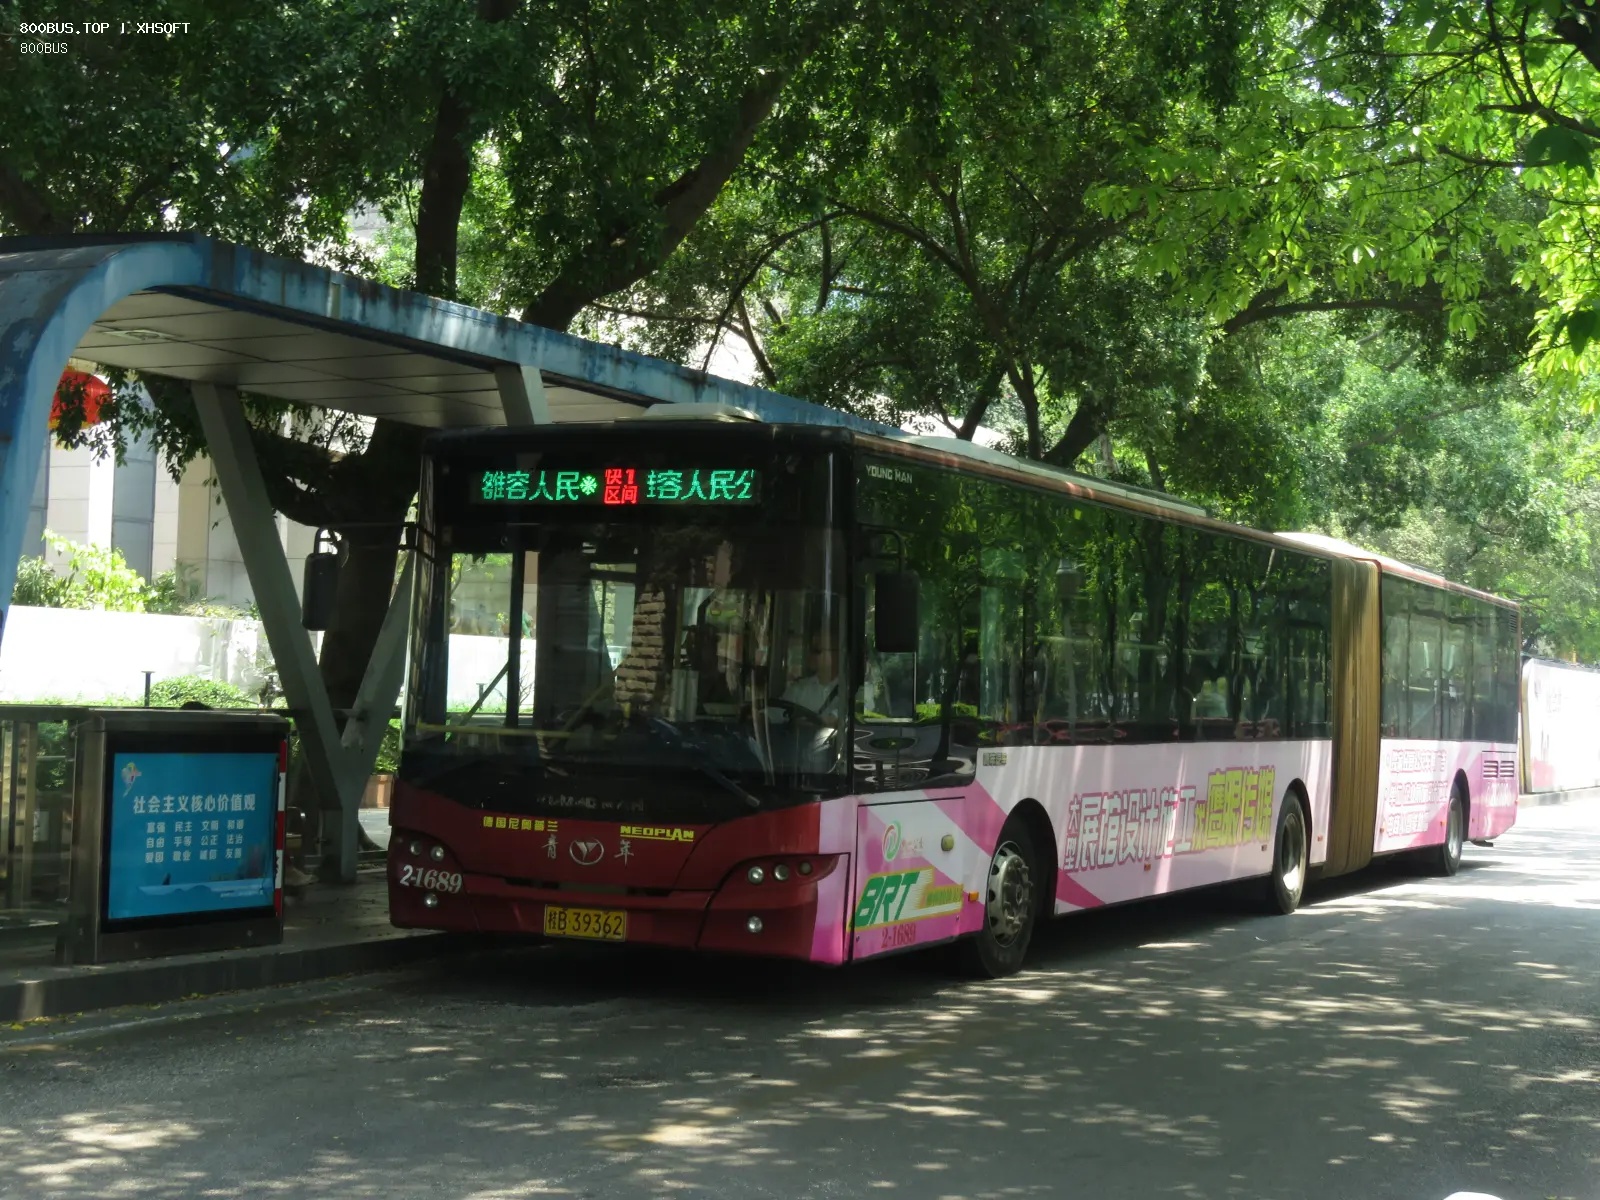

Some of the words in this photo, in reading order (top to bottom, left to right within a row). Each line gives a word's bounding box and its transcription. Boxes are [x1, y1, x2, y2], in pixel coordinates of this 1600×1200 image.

[866, 464, 893, 481] YOUNG
[895, 469, 913, 484] MAN
[604, 485, 638, 504] 区间
[133, 793, 257, 815] 社会主义核心价值观
[174, 821, 193, 833] 民主
[620, 825, 695, 842] NEOPLAN
[146, 836, 165, 849] 自由
[173, 835, 192, 847] 平等
[201, 834, 218, 846] 公正
[226, 833, 244, 845] 法治
[400, 864, 463, 894] 2-1689
[853, 871, 921, 928] BRT
[881, 922, 916, 948] 2-1689
